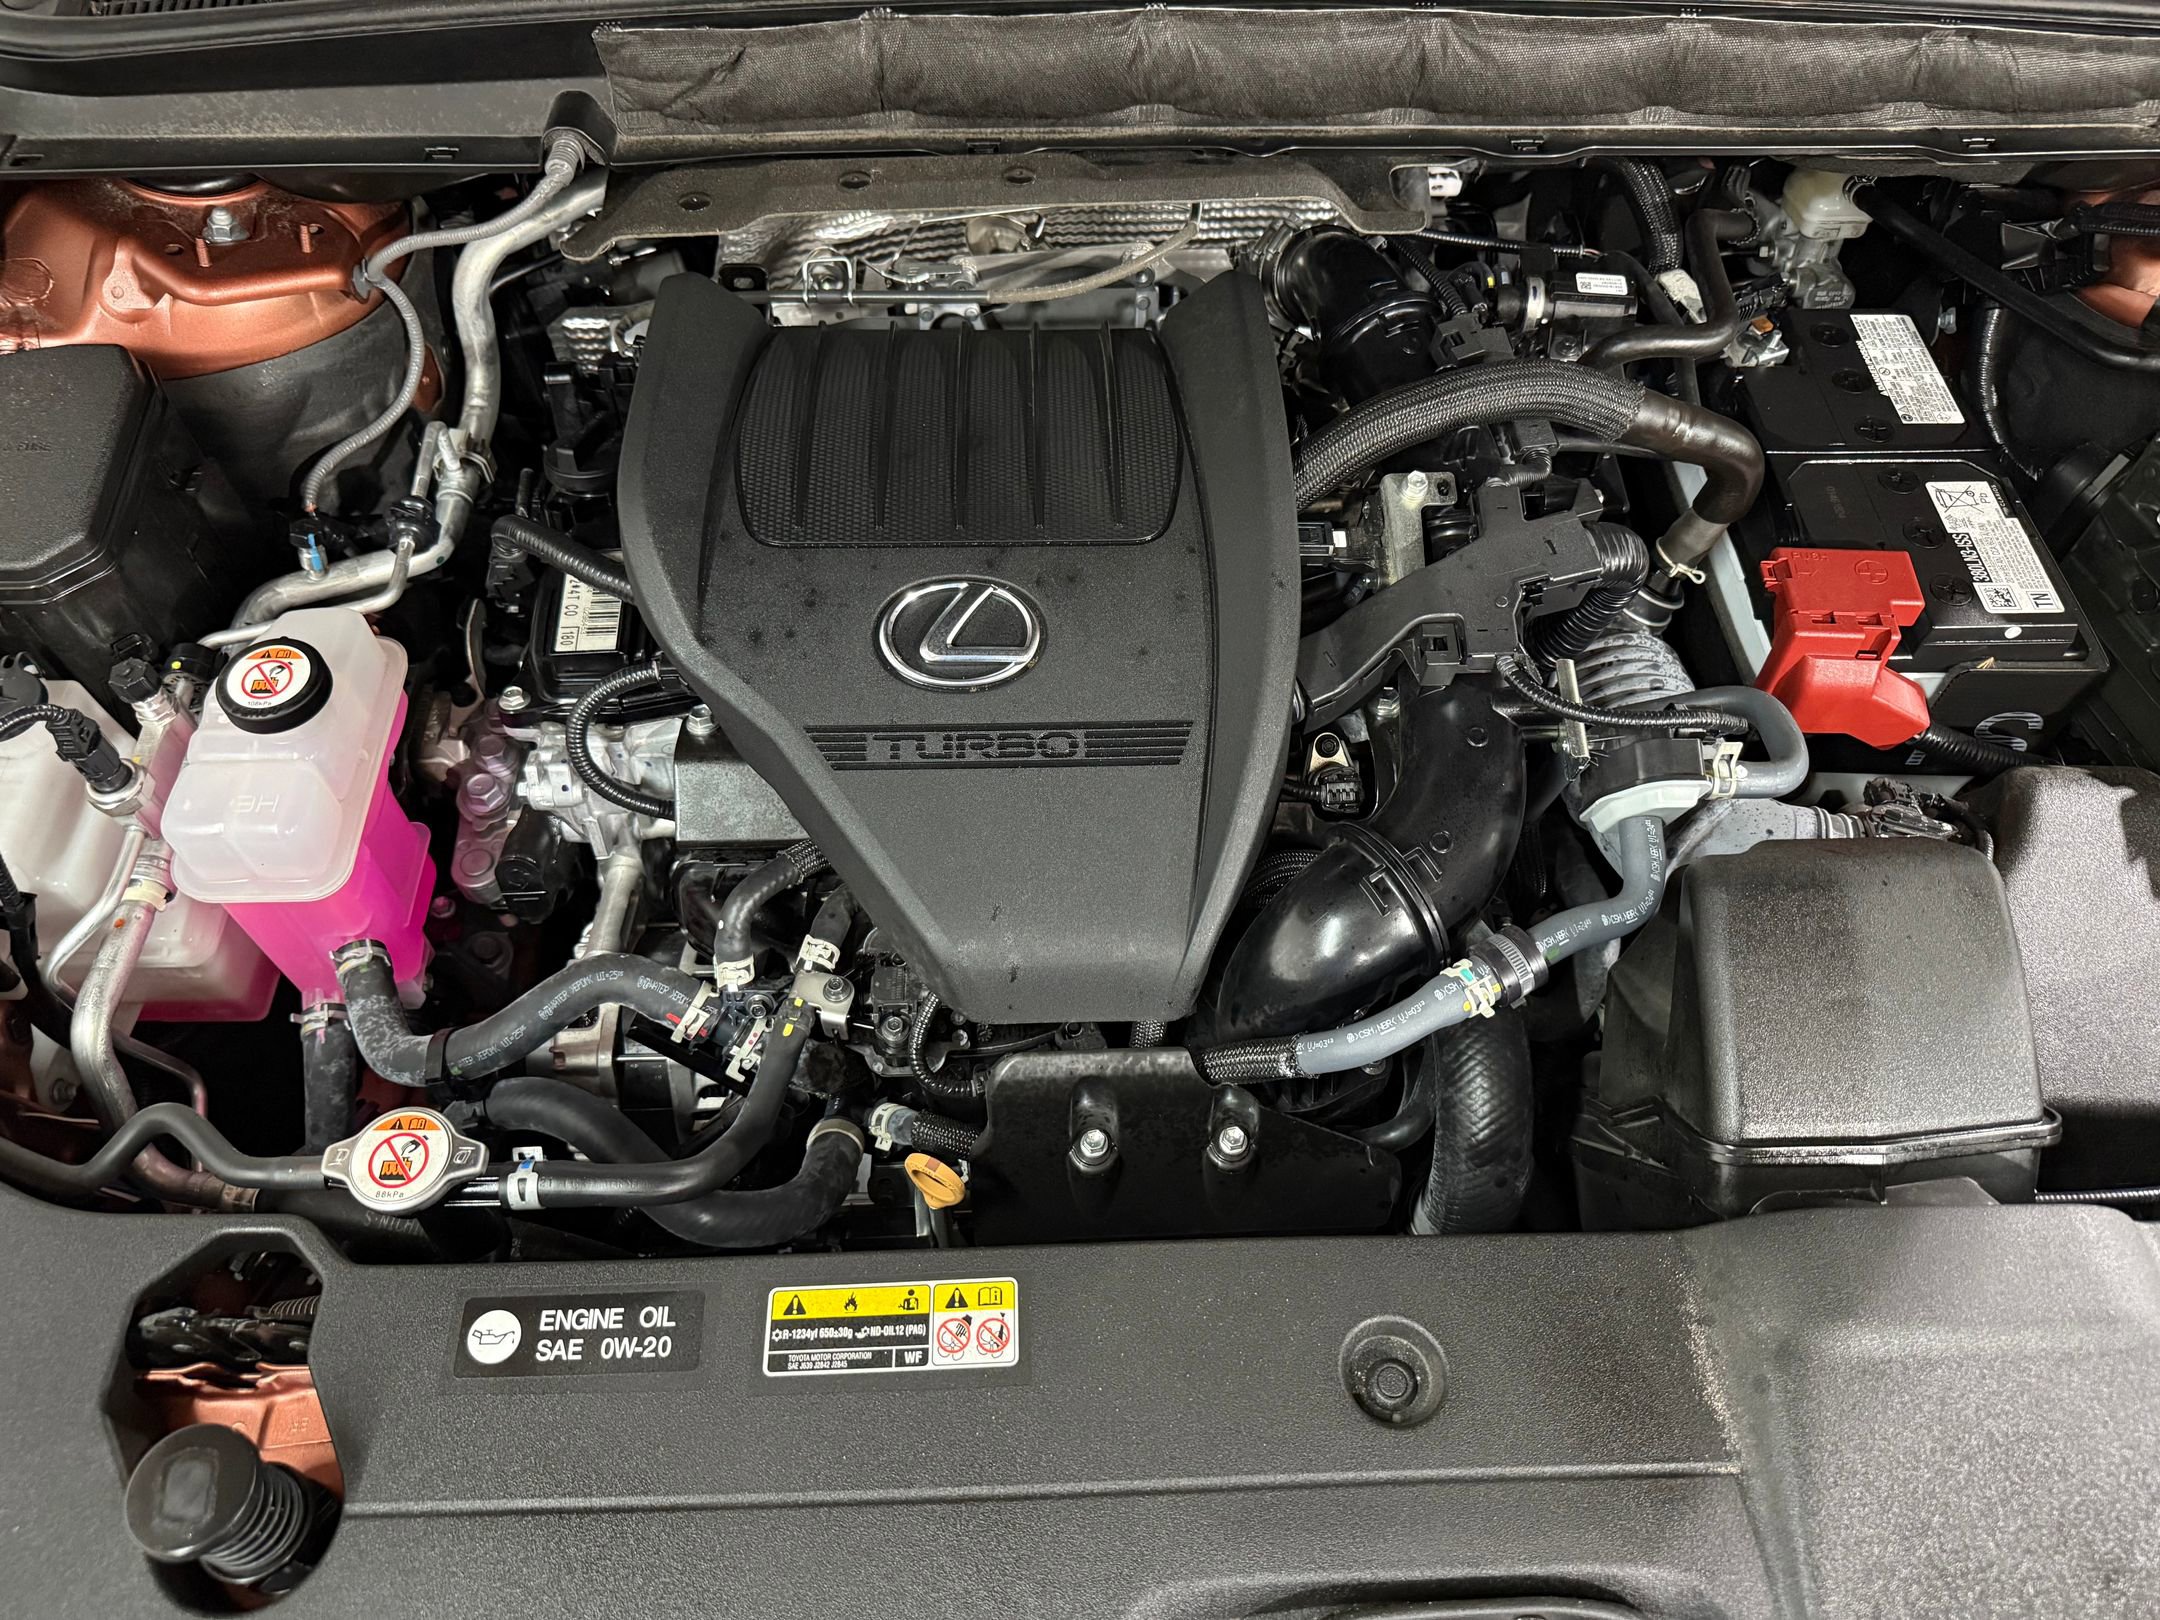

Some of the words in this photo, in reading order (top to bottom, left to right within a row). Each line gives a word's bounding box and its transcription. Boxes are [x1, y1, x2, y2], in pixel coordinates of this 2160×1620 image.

[1980, 492, 1991, 504] Pb
[1952, 533, 1990, 581] 380LN3-ISS
[2030, 593, 2053, 608] TN
[872, 731, 1080, 760] TURBO
[375, 1190, 404, 1198] 88kPa
[539, 1307, 625, 1331] ENGINE
[639, 1305, 676, 1328] OIL
[782, 1328, 818, 1341] R-1234yf
[535, 1338, 584, 1362] SAE
[600, 1335, 672, 1359] 0W-20
[788, 1354, 810, 1362] TOYOTA
[811, 1353, 831, 1361] MOTOR
[832, 1351, 872, 1361] CORPORATION
[904, 1350, 923, 1364] WF
[787, 1362, 799, 1370] SAE
